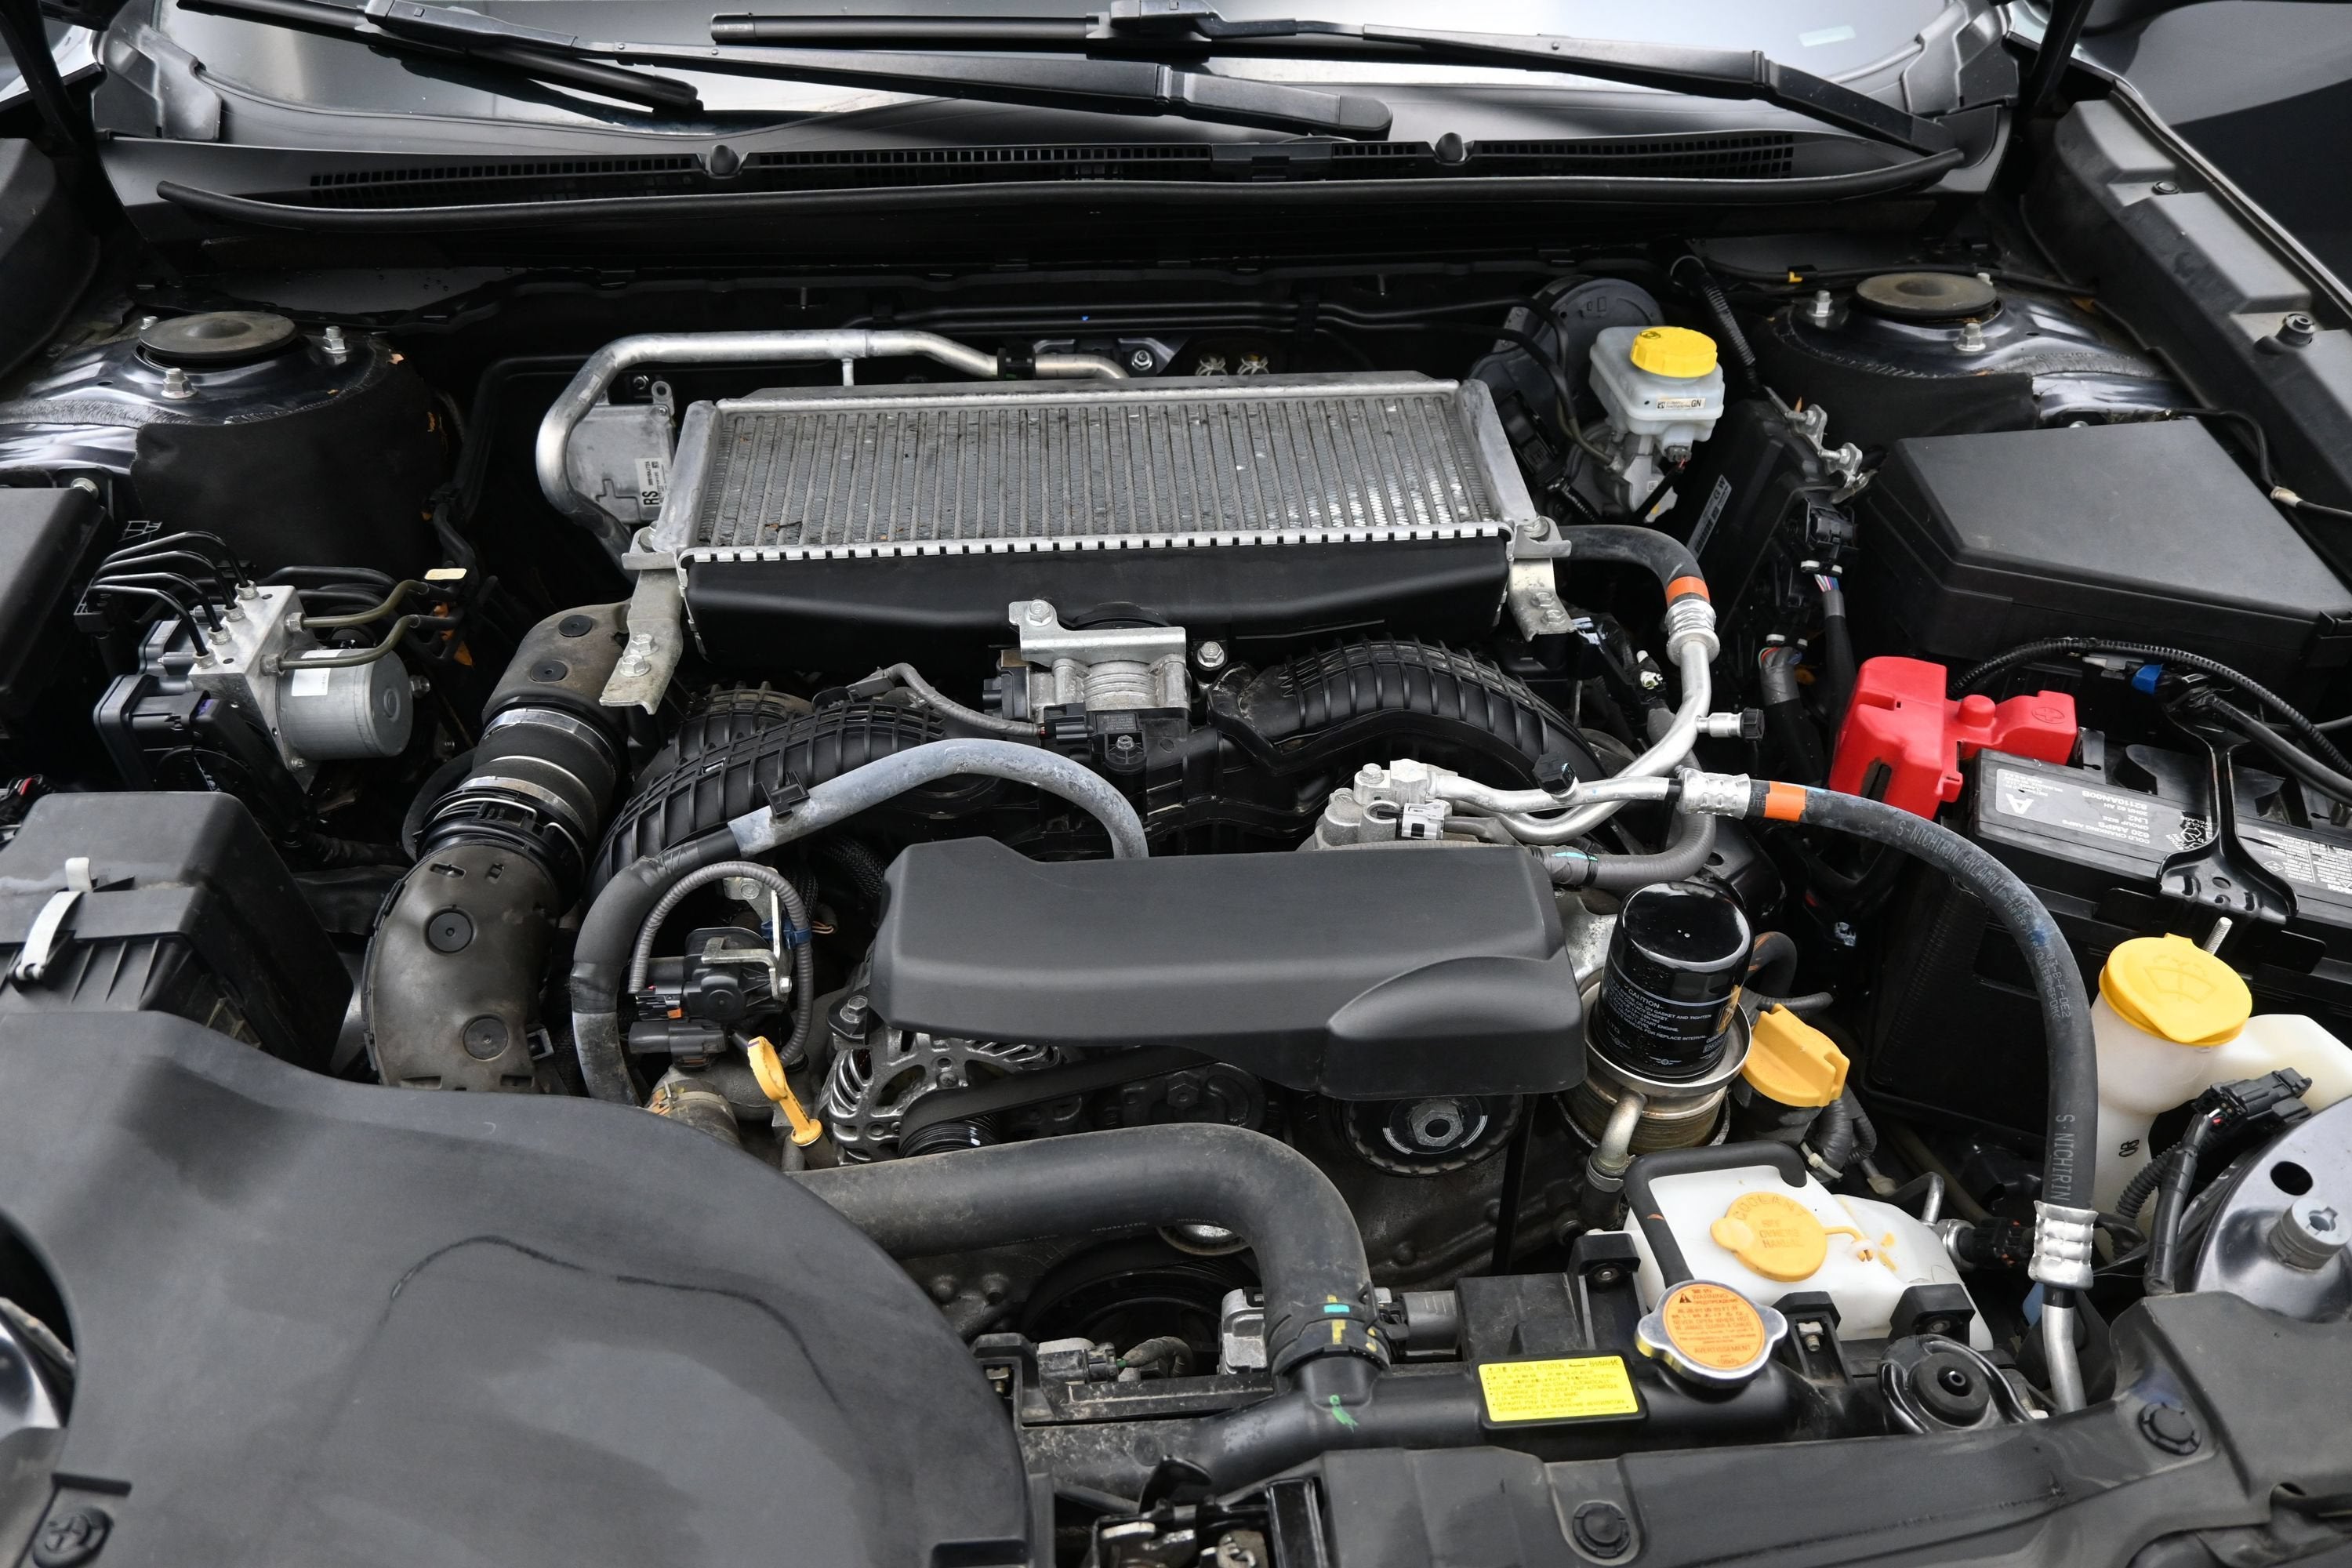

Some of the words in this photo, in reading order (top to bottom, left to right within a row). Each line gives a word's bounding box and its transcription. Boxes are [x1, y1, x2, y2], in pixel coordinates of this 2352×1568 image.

[642, 491, 659, 506] RS
[2062, 818, 2083, 829] AMPS
[2127, 815, 2148, 824] LN2
[2098, 822, 2129, 833] AMPS
[2121, 820, 2149, 830] GROUP
[2085, 825, 2127, 839] CRANKING
[2131, 829, 2150, 839] 620
[2128, 834, 2151, 844] COLD
[1653, 1010, 1675, 1018] GASKET
[1656, 1033, 1681, 1041] REPLACE
[1733, 1194, 1807, 1221] COOLANT
